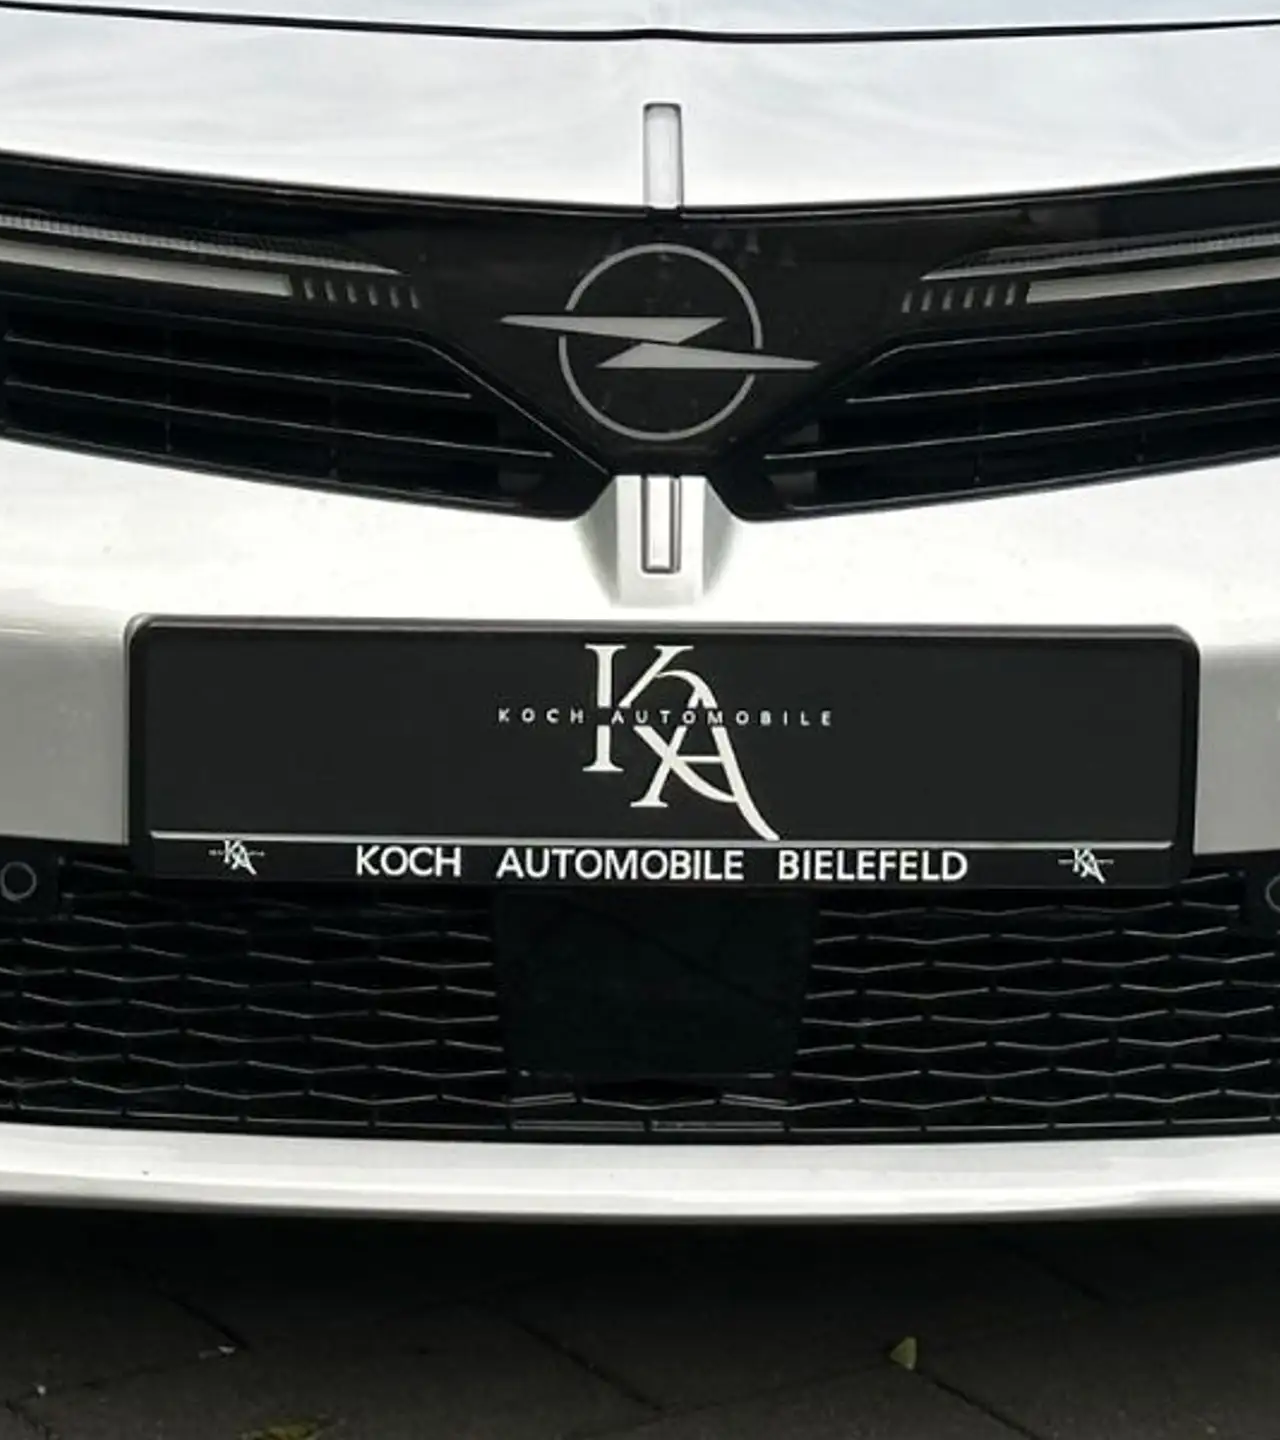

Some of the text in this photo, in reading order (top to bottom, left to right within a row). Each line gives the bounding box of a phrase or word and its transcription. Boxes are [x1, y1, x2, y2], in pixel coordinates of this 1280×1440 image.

[497, 708, 833, 727] KOCH AUTOMOBILE
[355, 844, 969, 882] KOCH AUTOMOBILE BIELEFELD
